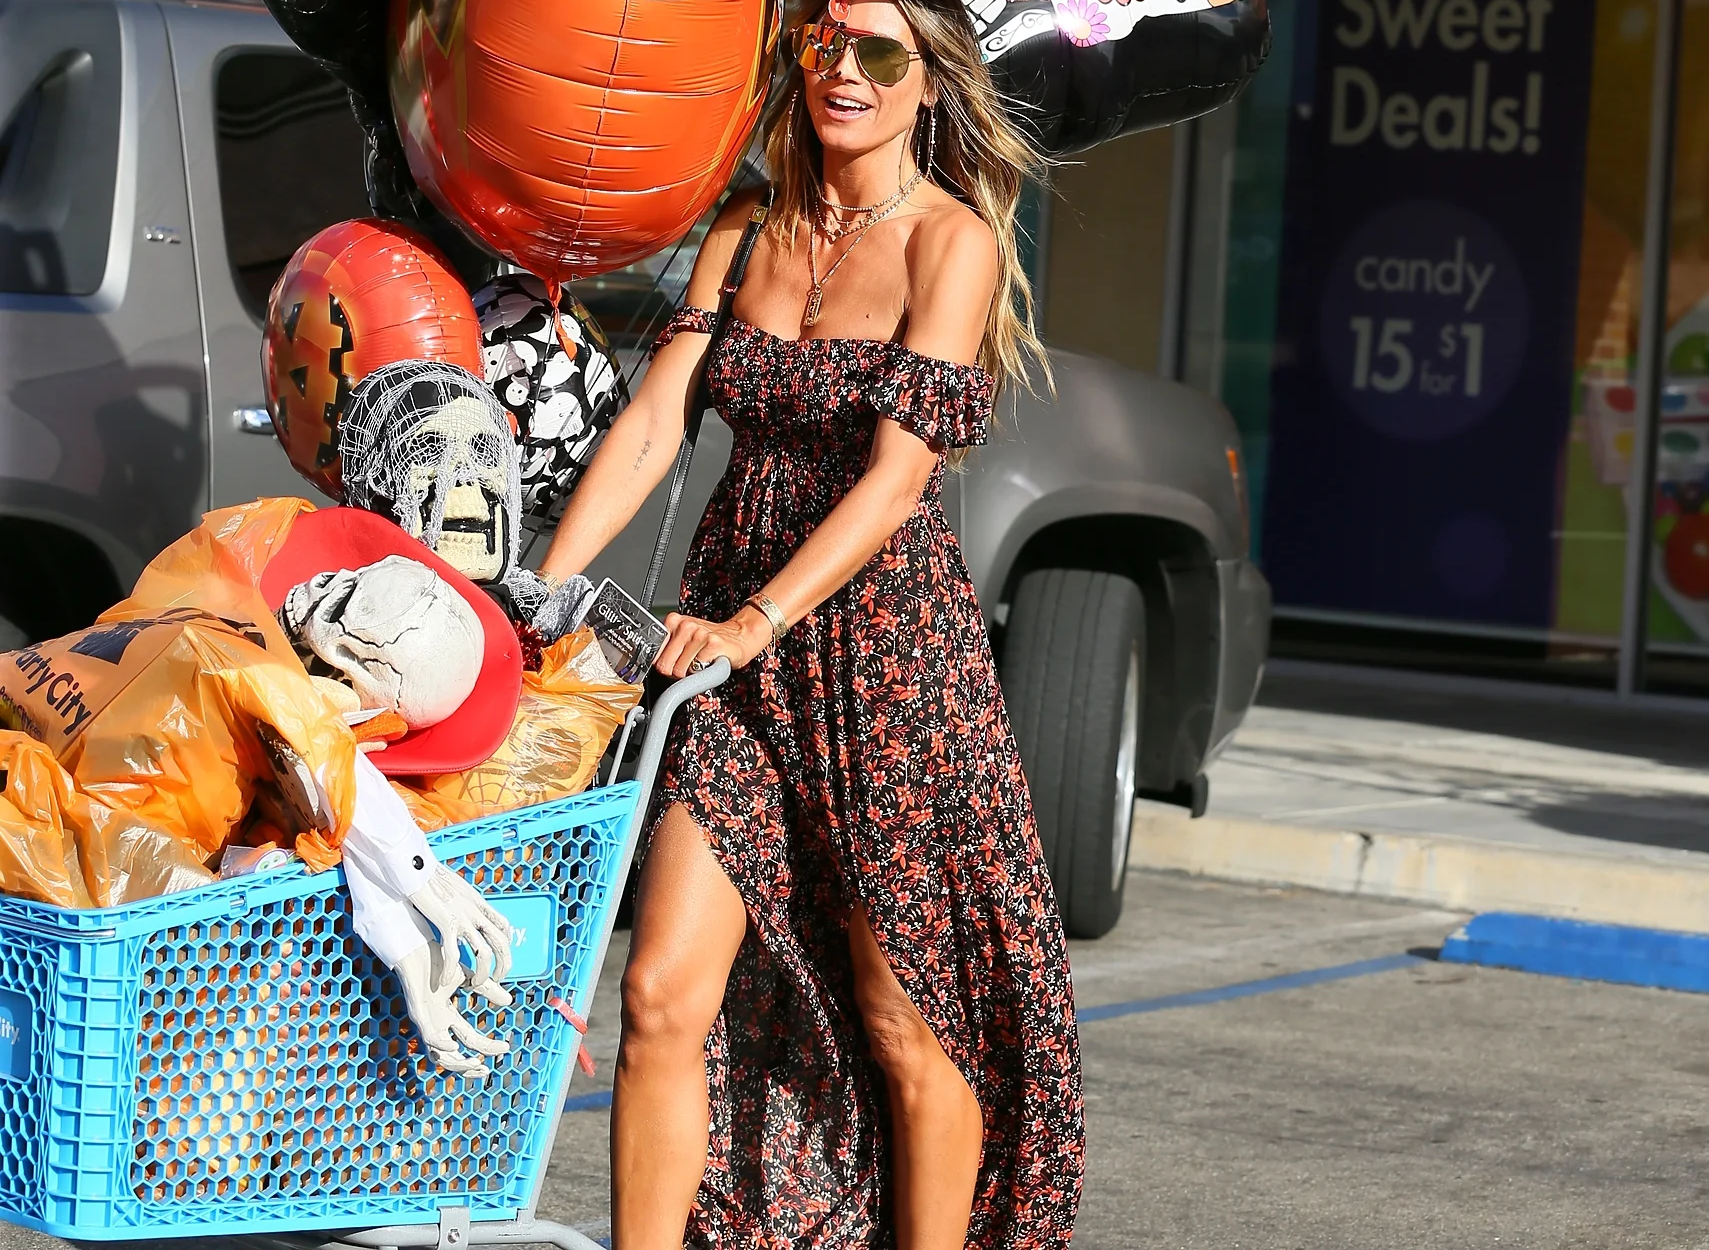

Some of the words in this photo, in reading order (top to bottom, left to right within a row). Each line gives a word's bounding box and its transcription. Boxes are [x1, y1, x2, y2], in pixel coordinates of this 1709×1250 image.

[1331, 60, 1542, 155] Deals!
[1355, 236, 1495, 312] candy
[1349, 316, 1414, 393] 15
[1419, 360, 1457, 396] for
[1440, 323, 1484, 398] $1
